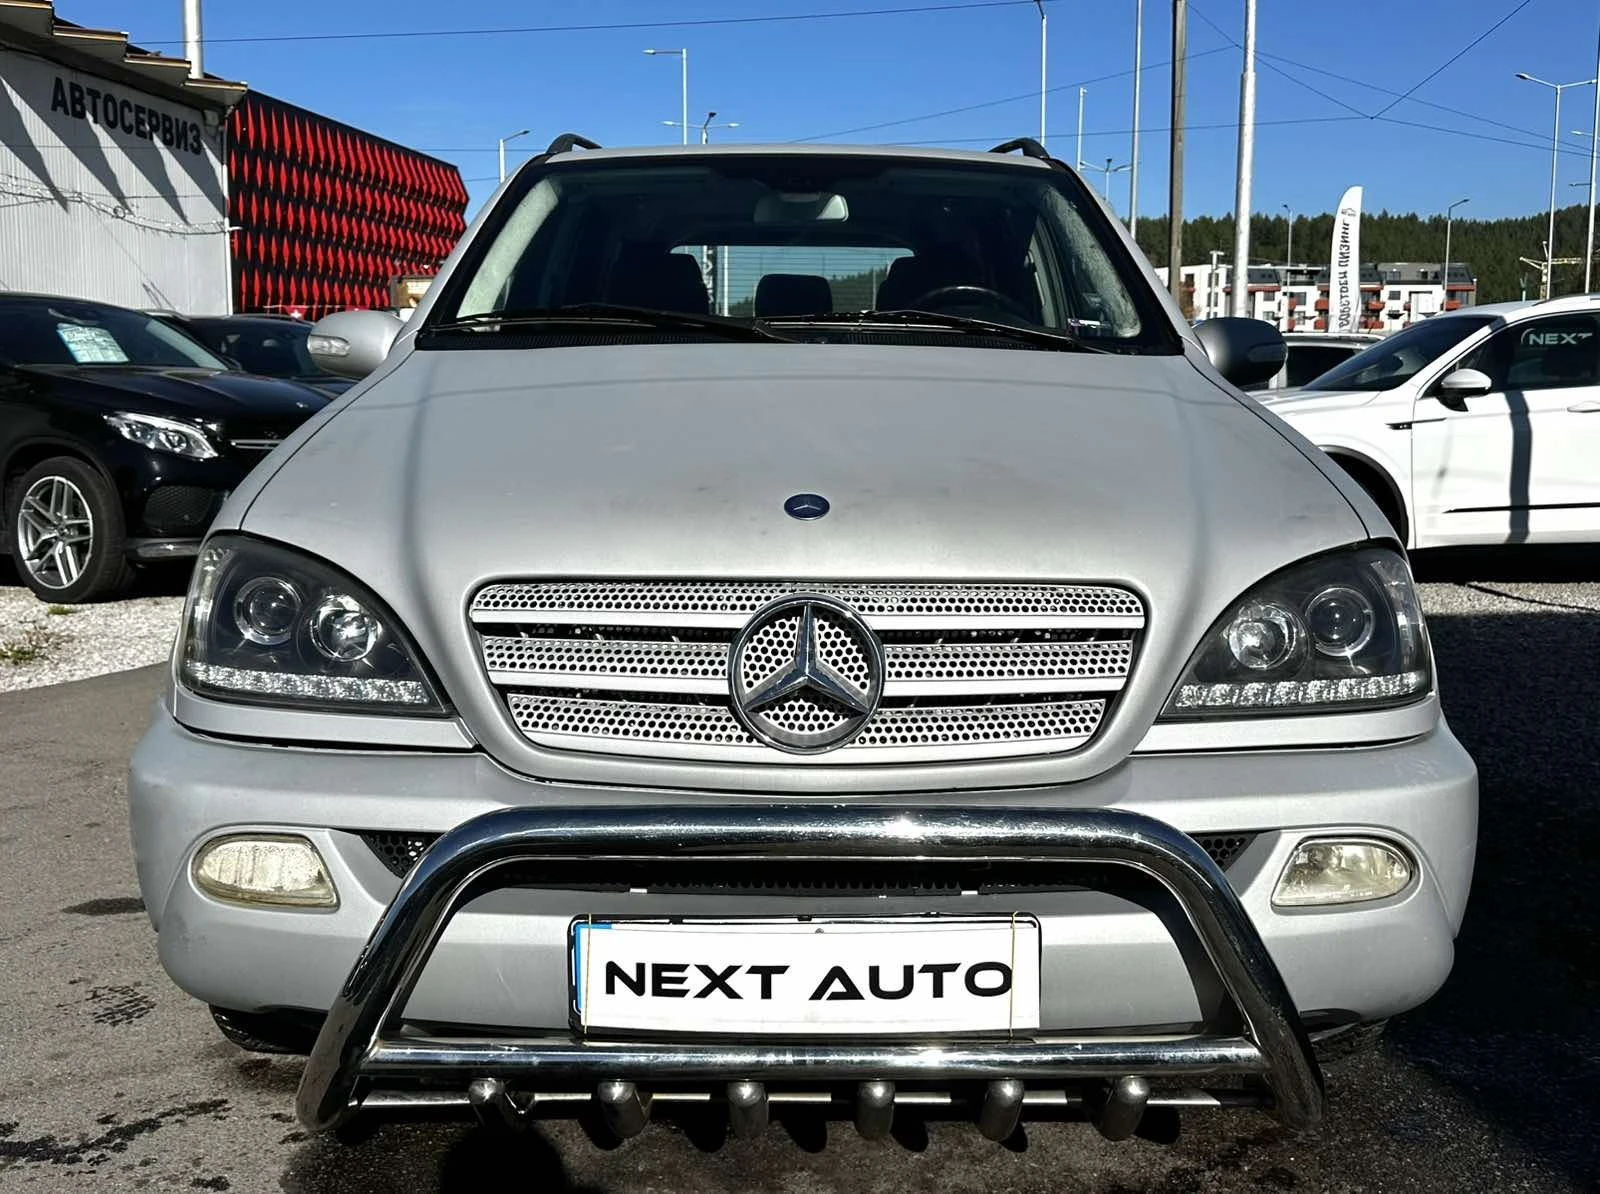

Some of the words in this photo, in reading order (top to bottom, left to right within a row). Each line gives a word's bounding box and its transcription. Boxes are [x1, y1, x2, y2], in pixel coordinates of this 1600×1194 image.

[51, 77, 203, 155] АВТОСЕРВИЗ
[605, 961, 790, 999] NEXT
[808, 961, 1013, 1001] AUTO
